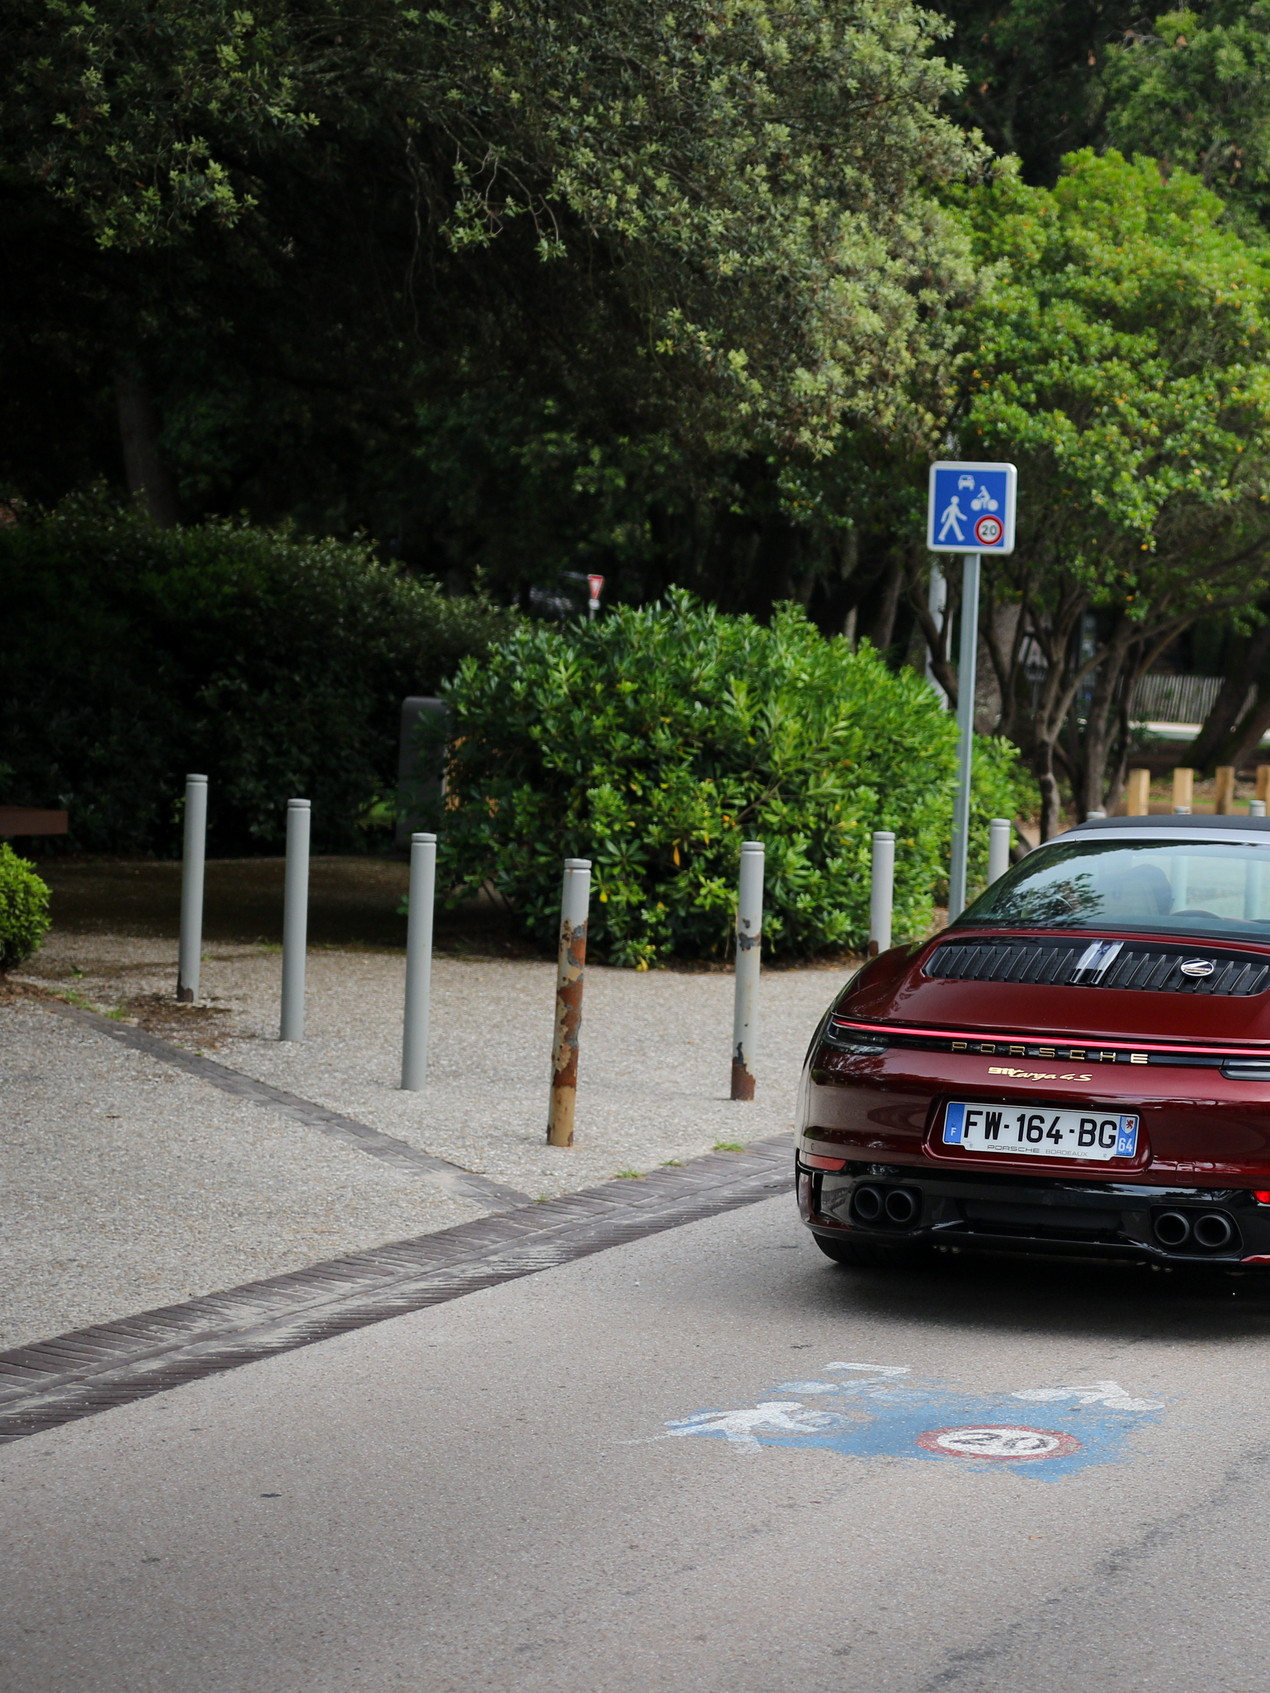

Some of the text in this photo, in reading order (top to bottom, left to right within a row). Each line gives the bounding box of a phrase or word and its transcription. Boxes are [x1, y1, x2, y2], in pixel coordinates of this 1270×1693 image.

[981, 525, 998, 536] 20
[951, 1041, 1149, 1064] PORSCHE
[950, 1127, 957, 1137] F
[987, 1144, 1089, 1157] PORSCHE BORDEAUX
[1117, 1137, 1134, 1152] 64
[948, 1432, 1049, 1451] 20
